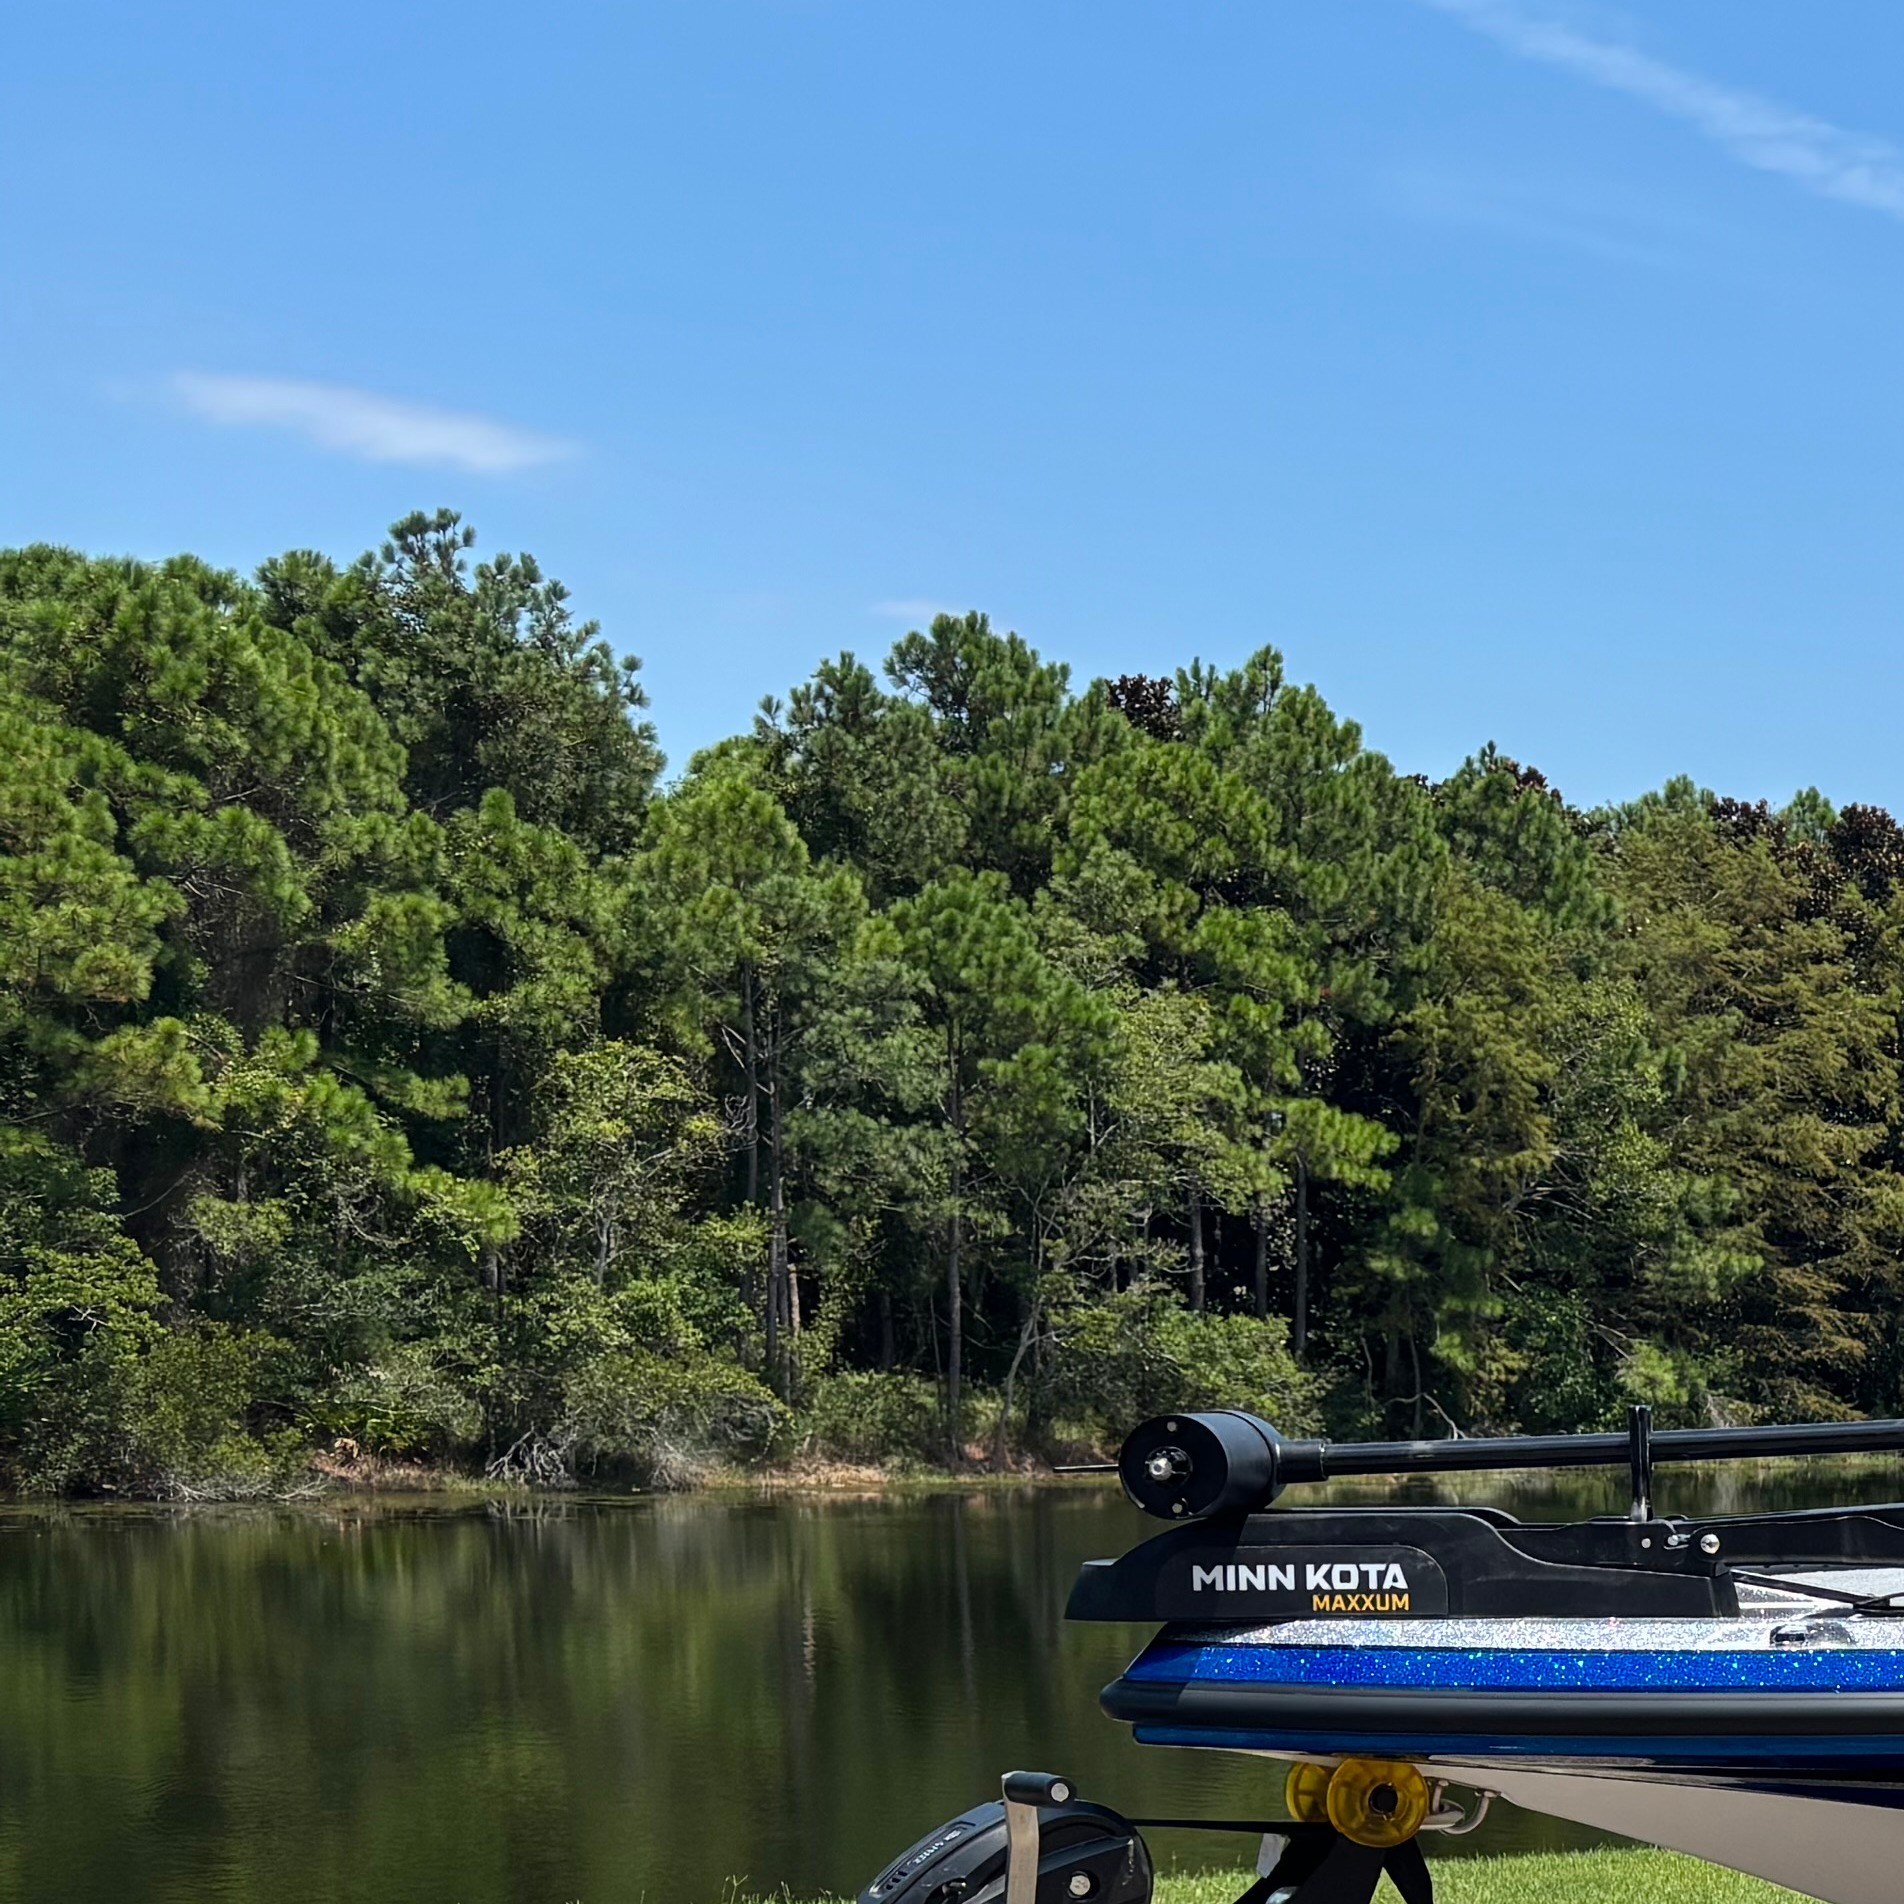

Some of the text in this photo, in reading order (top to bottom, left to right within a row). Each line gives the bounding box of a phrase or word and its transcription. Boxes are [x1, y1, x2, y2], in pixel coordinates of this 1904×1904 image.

[1192, 1563, 1409, 1591] MINN KOTA
[1312, 1593, 1410, 1611] MAXXUM
